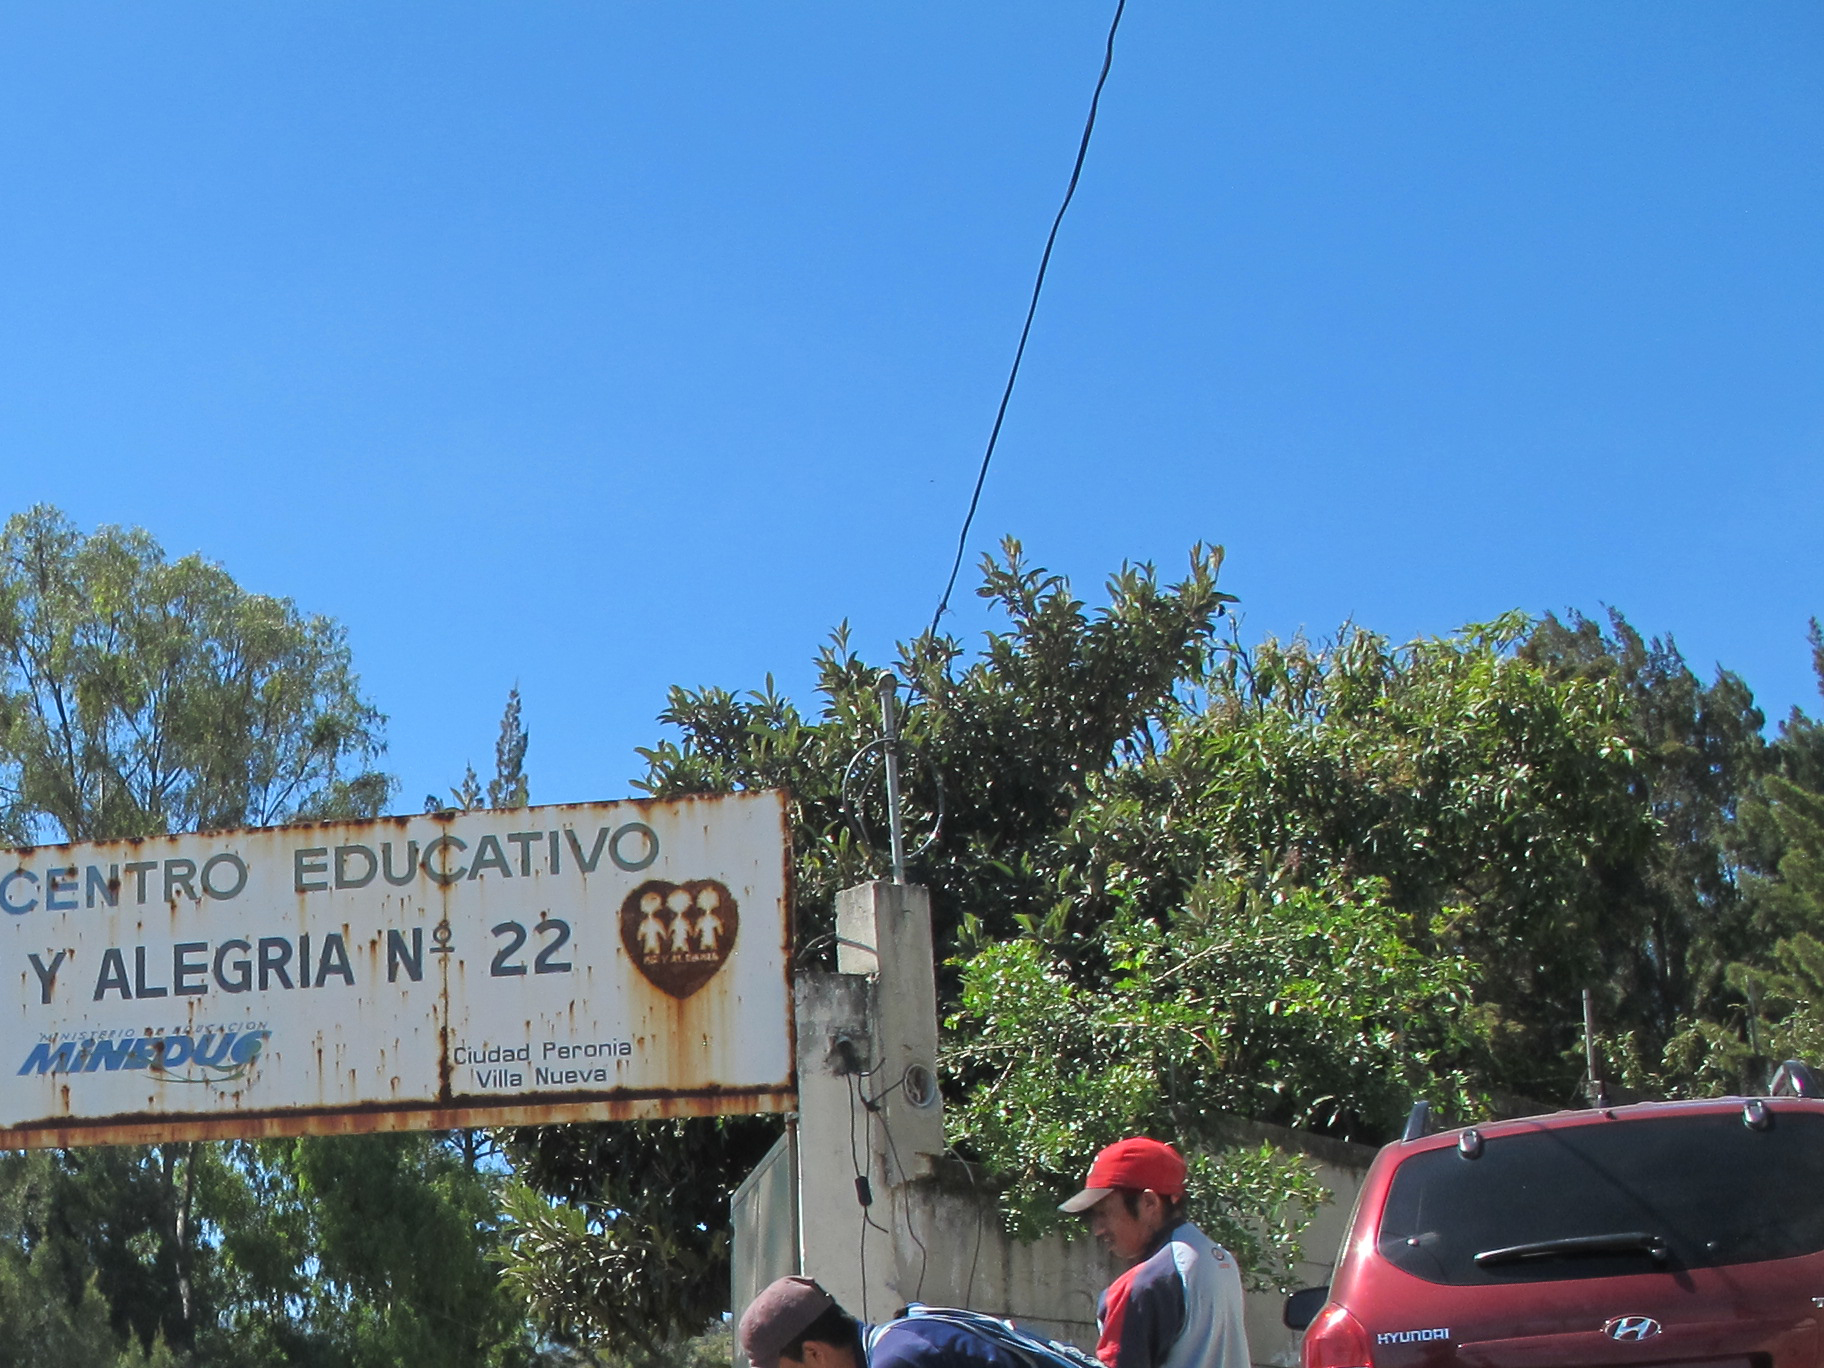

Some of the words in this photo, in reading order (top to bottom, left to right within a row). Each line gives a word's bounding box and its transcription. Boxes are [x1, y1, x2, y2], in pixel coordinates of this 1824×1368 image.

[294, 822, 659, 892] EDUCATIVO
[27, 952, 65, 1004] Y
[93, 933, 355, 1000] ALEGRIA
[491, 919, 572, 977] 22
[454, 1043, 530, 1065] Ciudad
[543, 1038, 632, 1060] Peronia
[476, 1069, 522, 1088] Villa
[536, 1067, 607, 1086] Nueva
[1377, 1328, 1449, 1345] HYUNDAI
